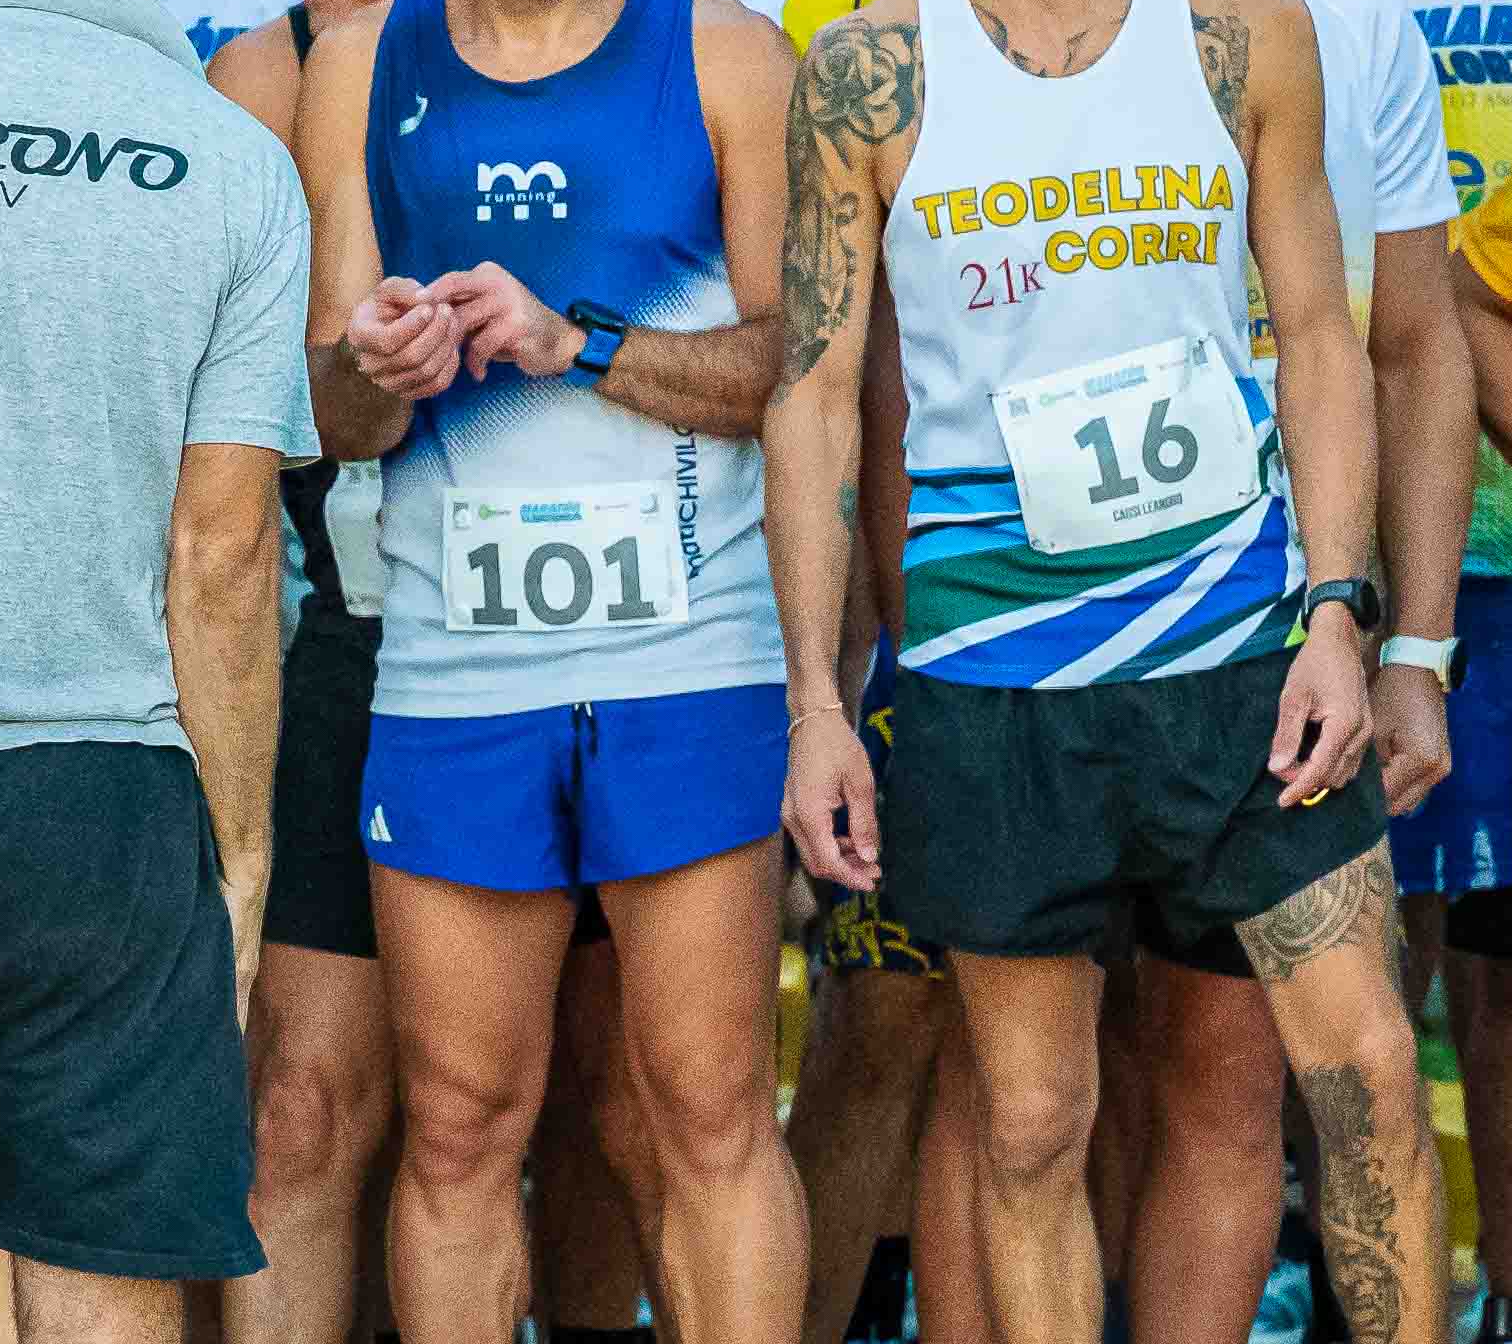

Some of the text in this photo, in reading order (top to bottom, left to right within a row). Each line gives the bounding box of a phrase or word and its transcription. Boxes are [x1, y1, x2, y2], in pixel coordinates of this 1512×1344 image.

[484, 191, 556, 205] running
[912, 164, 1234, 240] TEODELINA
[1073, 397, 1199, 505] 16
[467, 536, 657, 626] 101
